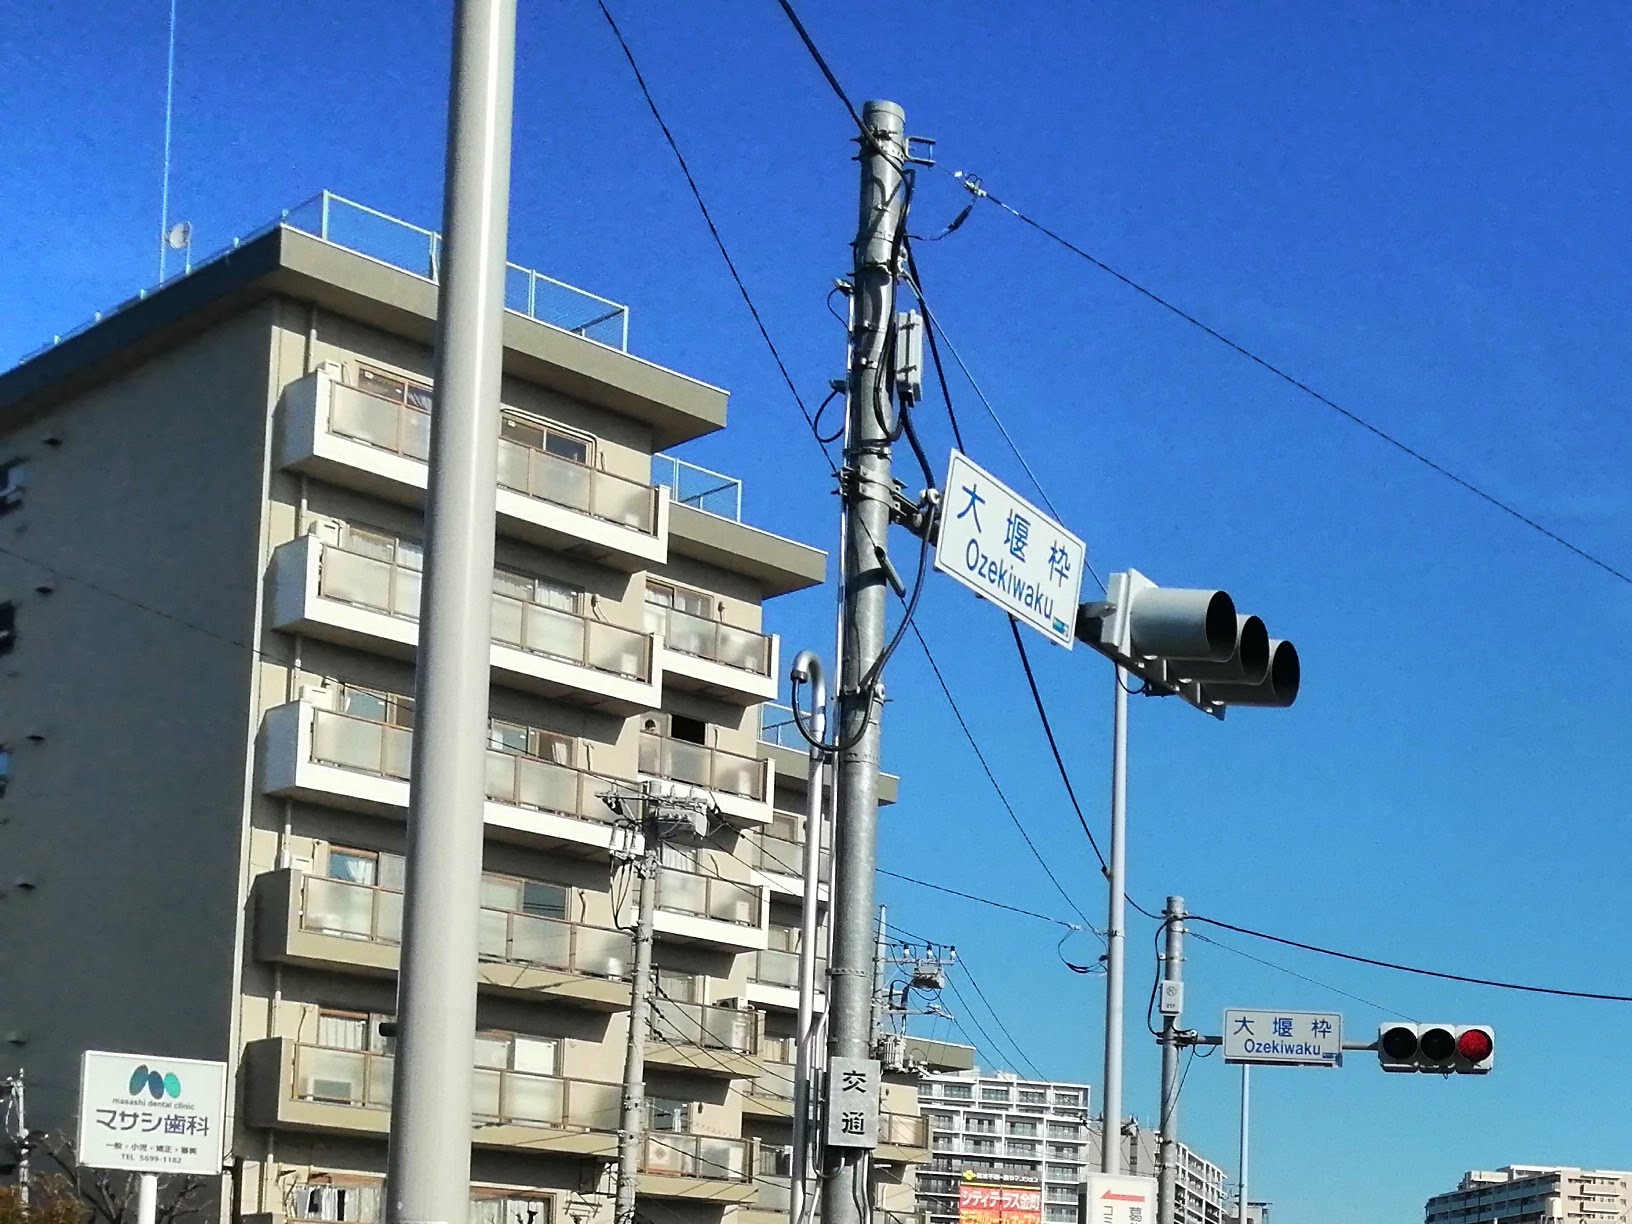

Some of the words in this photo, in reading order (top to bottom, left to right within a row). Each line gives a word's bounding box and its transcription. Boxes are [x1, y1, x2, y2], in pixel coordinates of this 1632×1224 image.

[957, 484, 1071, 587] 大堰枠
[966, 538, 1053, 618] Ozekiwaku
[1233, 1016, 1332, 1039] 大堰枠
[1244, 1038, 1320, 1056] Ozekiwaku
[96, 1108, 209, 1136] マサシ歯科
[841, 1070, 866, 1135] 交通
